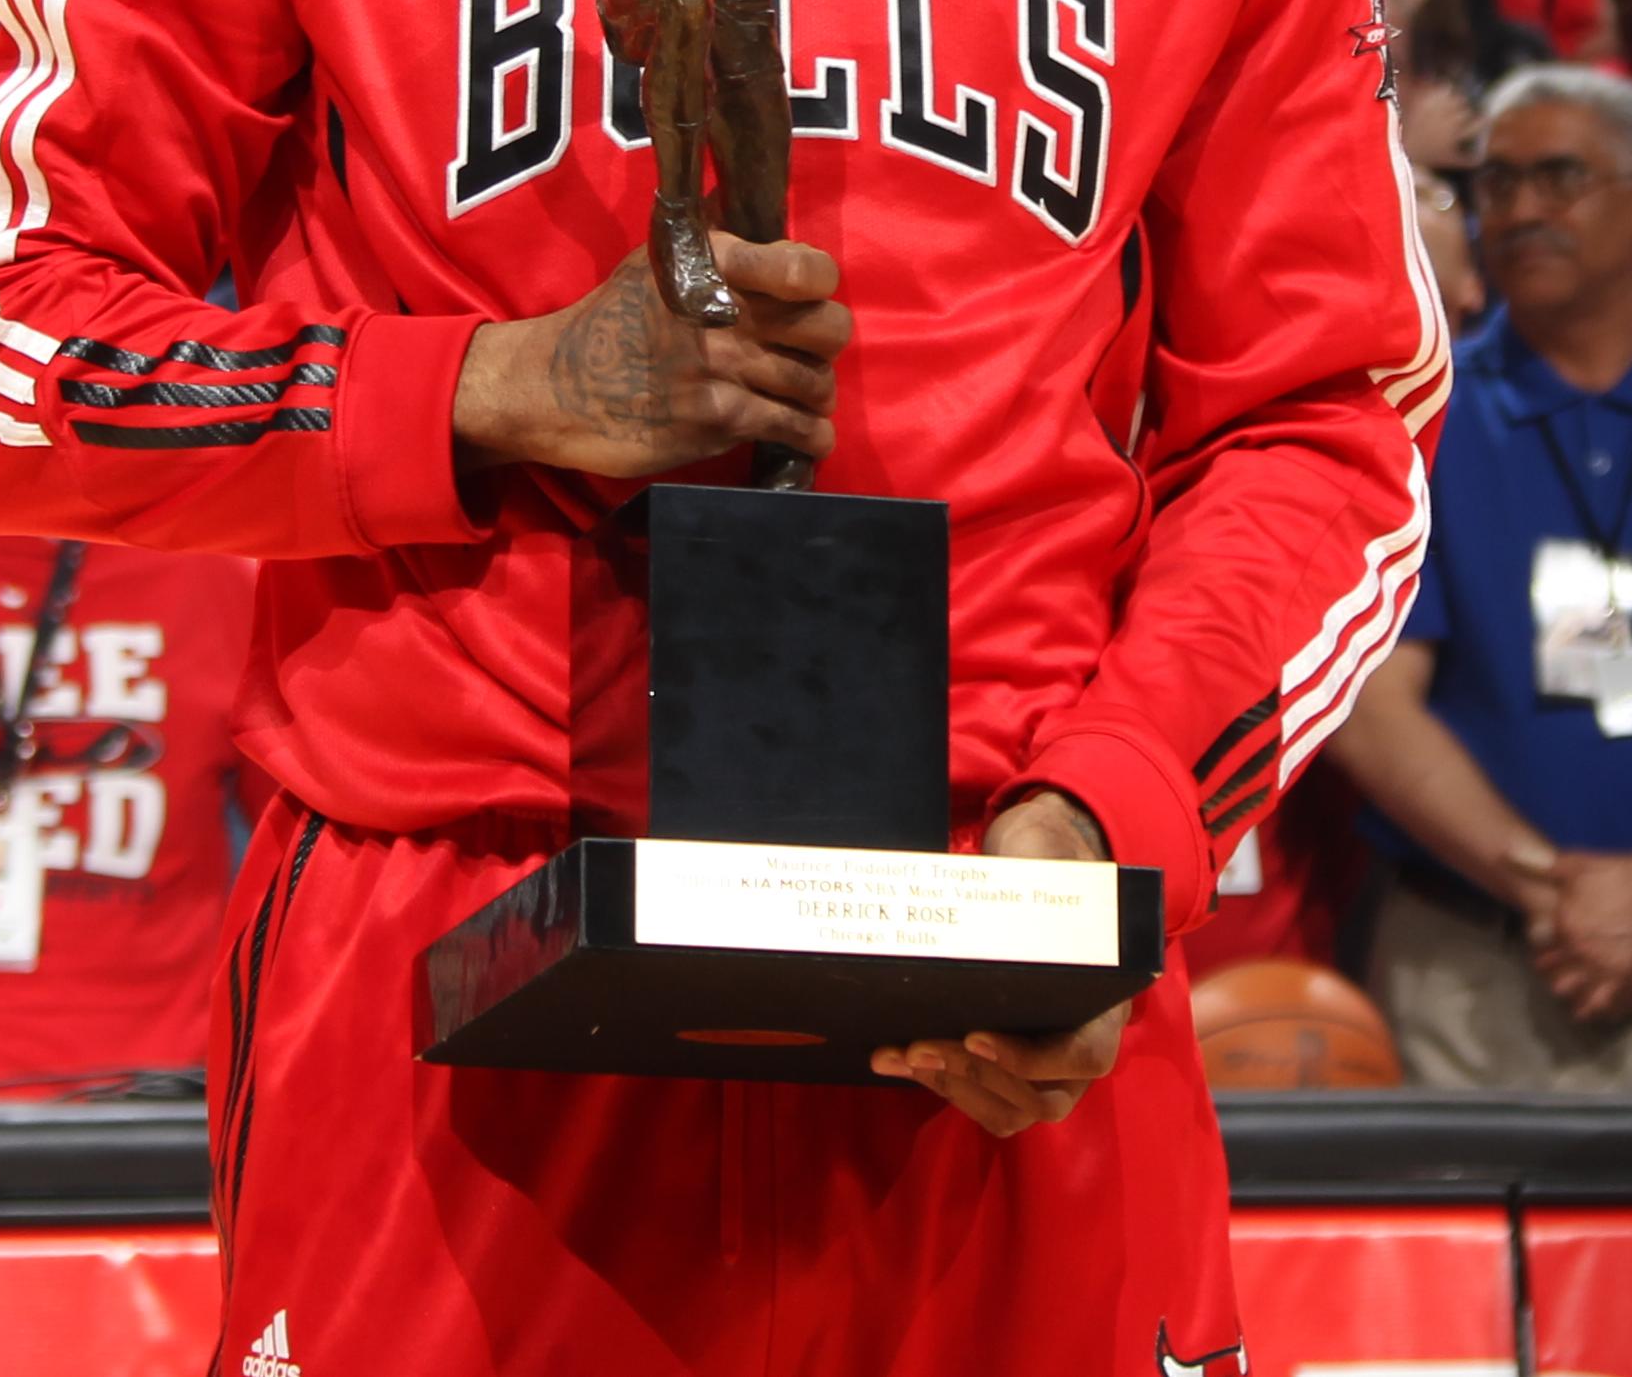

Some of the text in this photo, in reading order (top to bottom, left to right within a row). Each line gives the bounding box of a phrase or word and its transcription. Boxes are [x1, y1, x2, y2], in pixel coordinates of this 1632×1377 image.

[932, 864, 990, 881] Trophy
[741, 877, 771, 889] KIA
[780, 879, 854, 893] MOTORS
[909, 885, 944, 898] Most
[954, 886, 1023, 903] Valuable
[1033, 890, 1083, 907] Player
[798, 900, 959, 925] DERRICK ROSE
[819, 927, 938, 945] Chicago Bulls
